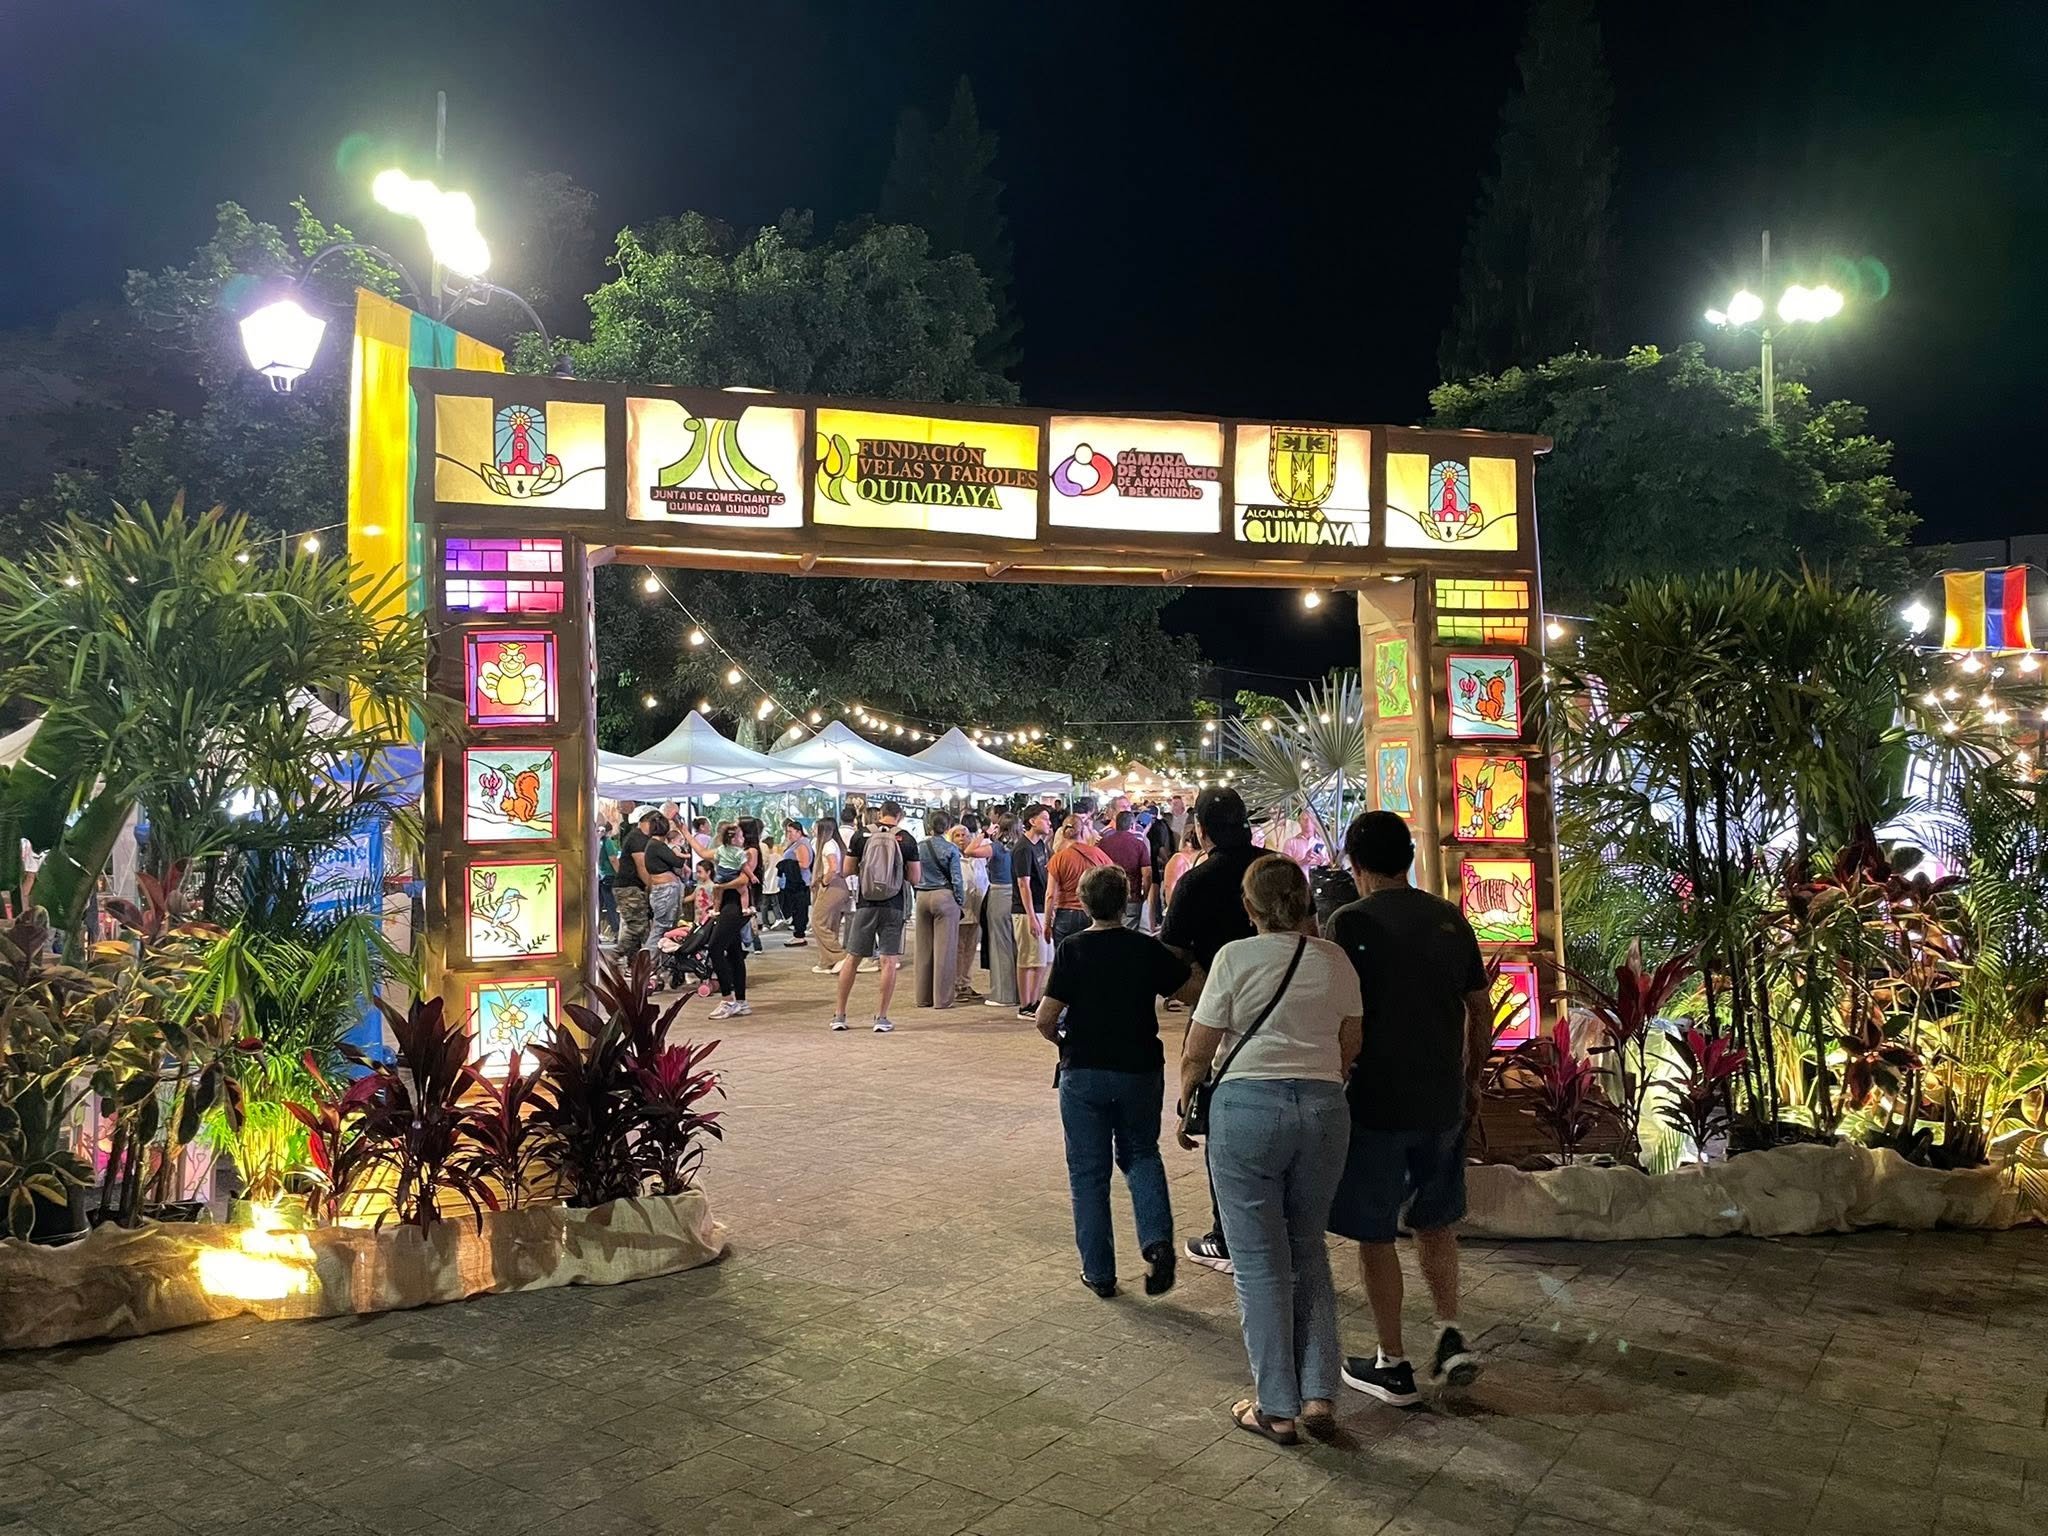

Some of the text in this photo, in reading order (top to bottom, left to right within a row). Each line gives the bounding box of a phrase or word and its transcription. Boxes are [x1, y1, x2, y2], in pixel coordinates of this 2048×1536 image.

[858, 440, 984, 464] FUNDACIÓN
[1117, 448, 1186, 466] CÁMARA
[859, 457, 1038, 488] VELAS Y FAROLES
[1117, 464, 1218, 480] DE COMERCIO
[1117, 477, 1187, 488] DE ARMENIA
[653, 489, 785, 505] JUNTA DE COMERCIANTES
[857, 478, 1002, 509] QUIMBAYA
[1119, 486, 1202, 498] Y DEL QUINDÍO
[669, 502, 768, 515] QUIMBAYA QUINDÍO
[1246, 509, 1310, 519] ALCALDÍA DE
[1246, 520, 1359, 546] QUIMBAYA
